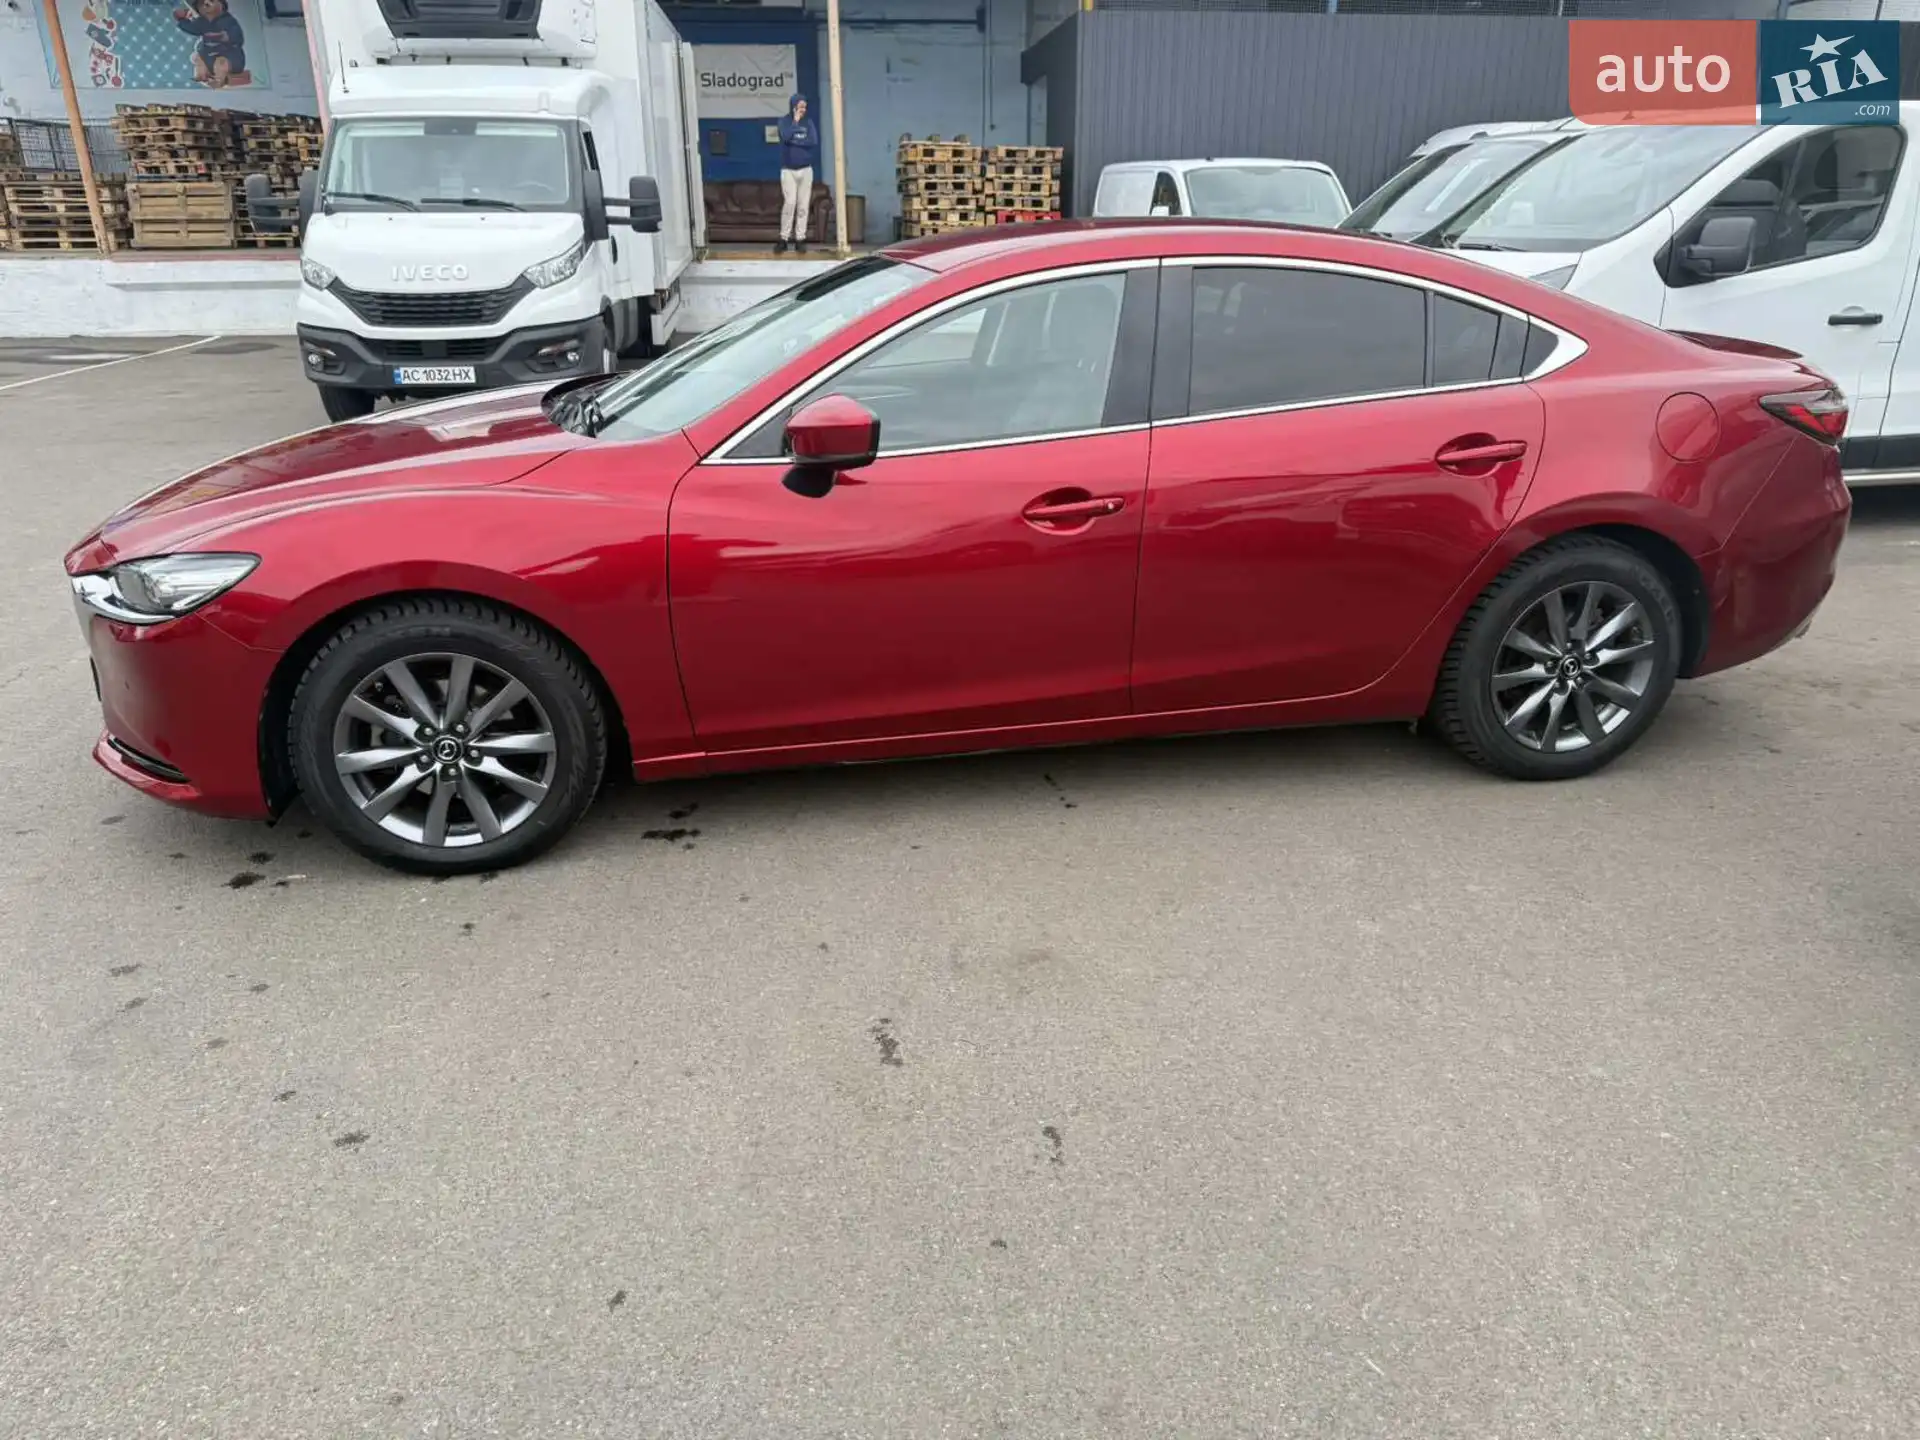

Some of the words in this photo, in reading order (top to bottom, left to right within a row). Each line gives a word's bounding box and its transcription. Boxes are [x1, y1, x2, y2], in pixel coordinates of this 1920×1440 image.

[700, 72, 784, 92] Sladograd
[391, 263, 469, 282] IVECO
[403, 369, 420, 382] AC
[423, 369, 451, 382] 1032
[452, 368, 471, 381] HX
